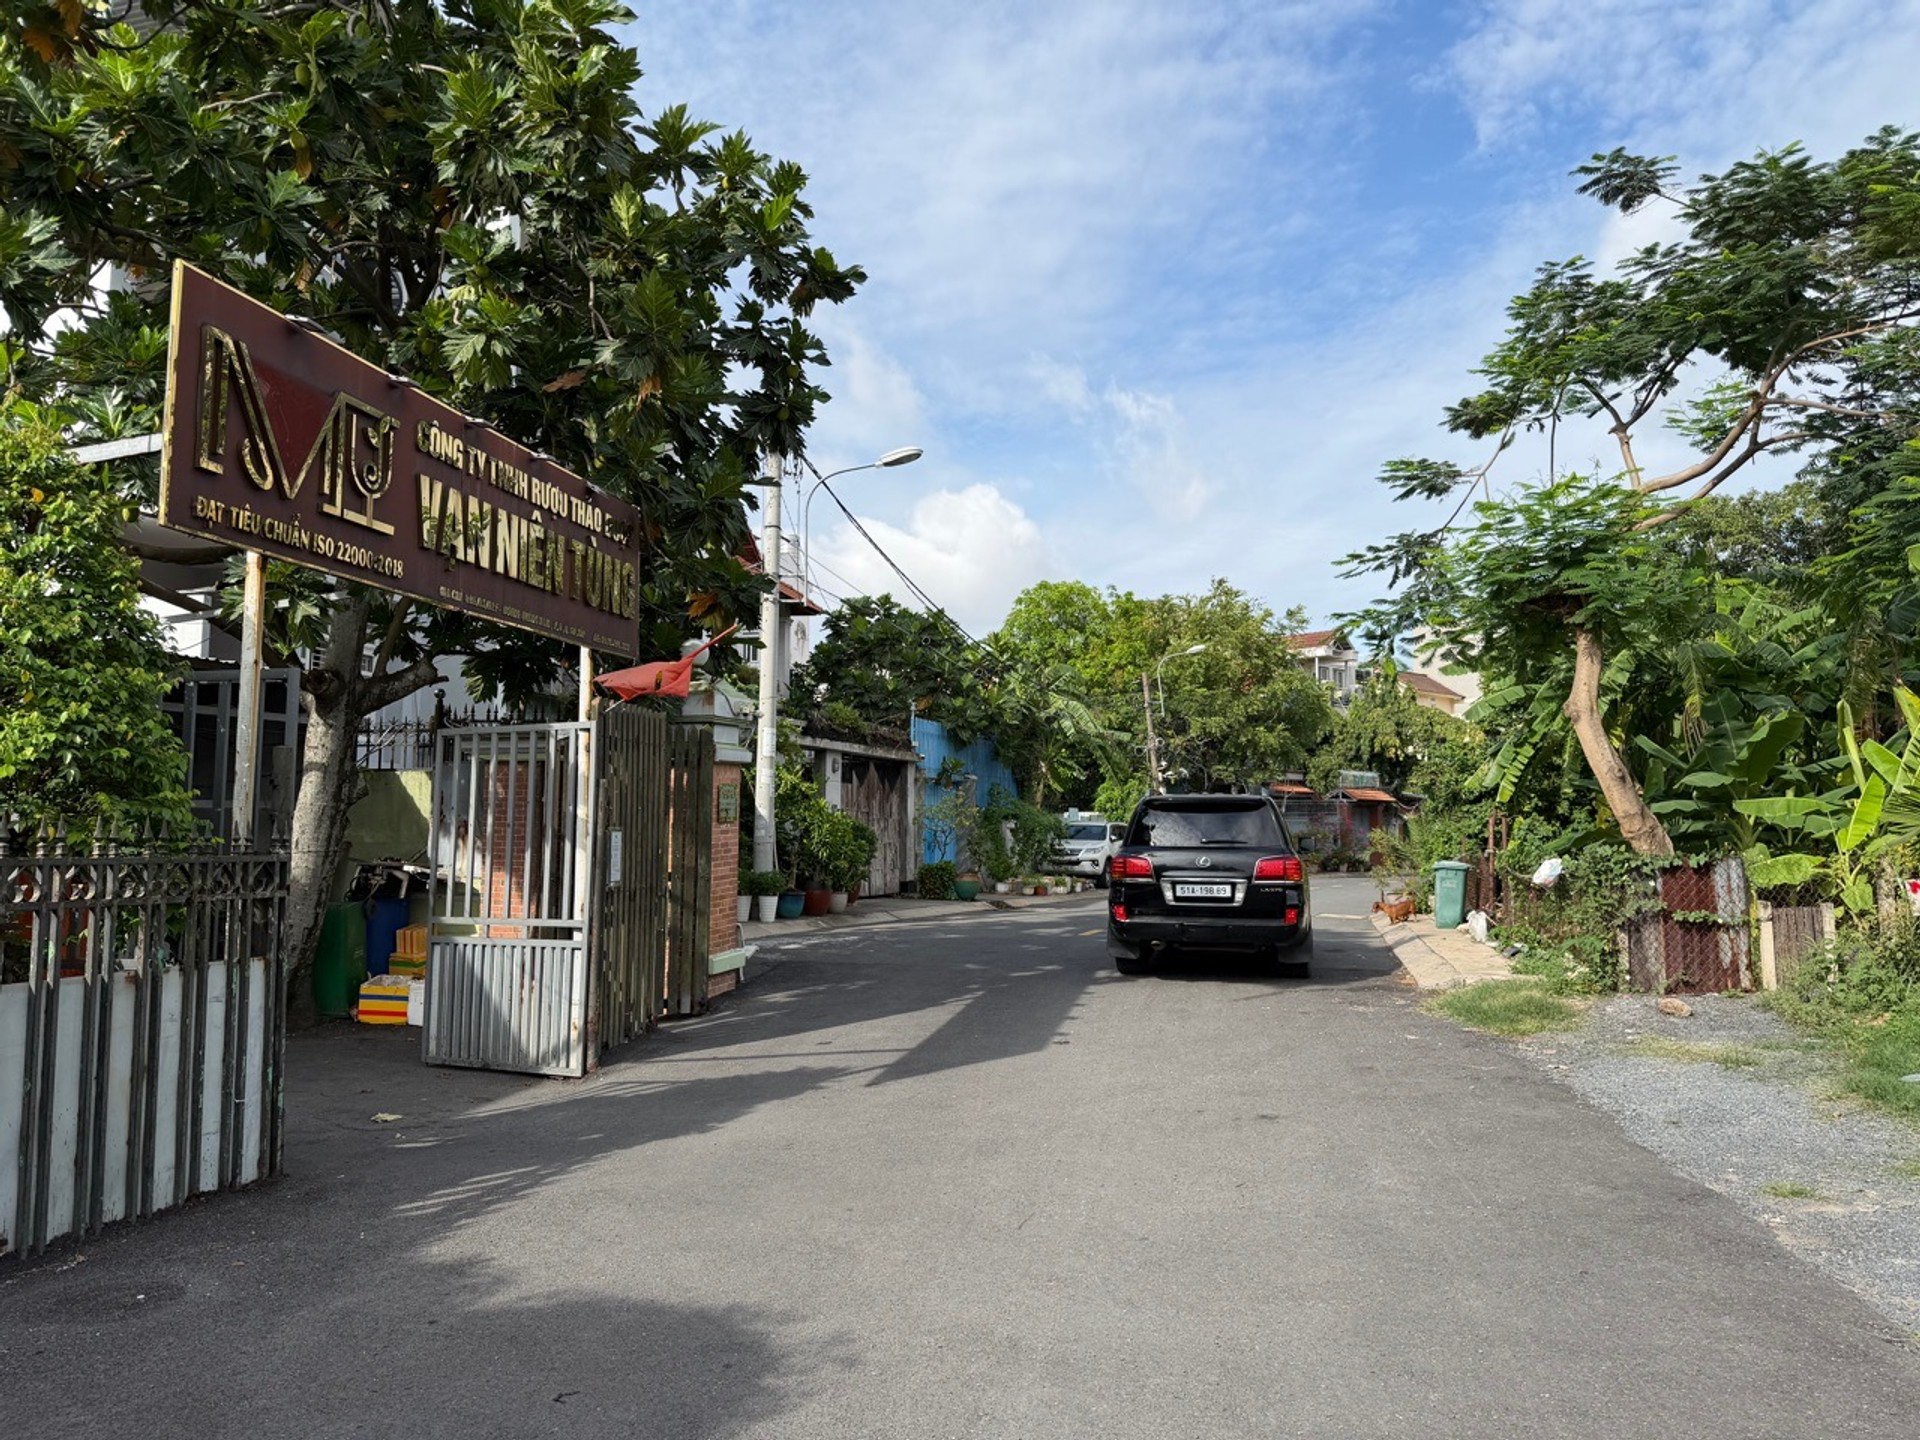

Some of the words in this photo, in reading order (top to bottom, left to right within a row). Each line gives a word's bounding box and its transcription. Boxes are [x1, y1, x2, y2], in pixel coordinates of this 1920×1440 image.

[416, 419, 464, 470] CÔNG
[467, 445, 487, 480] TY
[530, 477, 568, 520] RƯỢU
[196, 495, 225, 529] ĐẠT
[230, 503, 262, 535] TIÊU
[264, 512, 311, 550] CHUẨN
[312, 532, 335, 558] ISO
[337, 541, 404, 579] 22000:2018
[418, 473, 492, 571] VẠN
[496, 508, 566, 596] NIÊN
[569, 535, 636, 620] TÙNG
